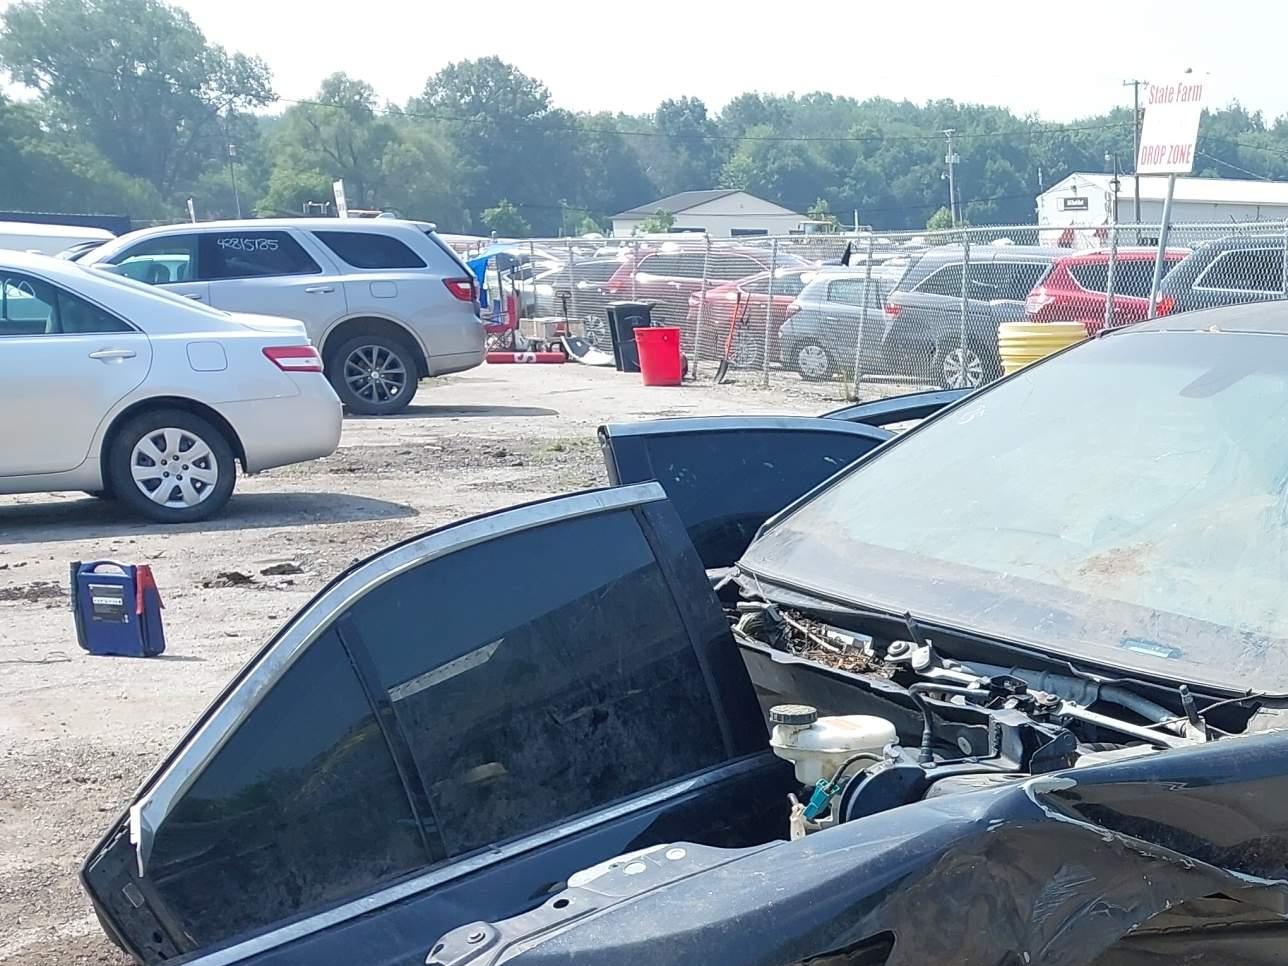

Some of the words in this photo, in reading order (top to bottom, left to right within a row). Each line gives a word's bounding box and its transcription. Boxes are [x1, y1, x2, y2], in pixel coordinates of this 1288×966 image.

[1149, 84, 1174, 105] State
[1176, 82, 1202, 103] Farm
[1140, 146, 1166, 165] DROP
[1167, 144, 1192, 164] ZONE
